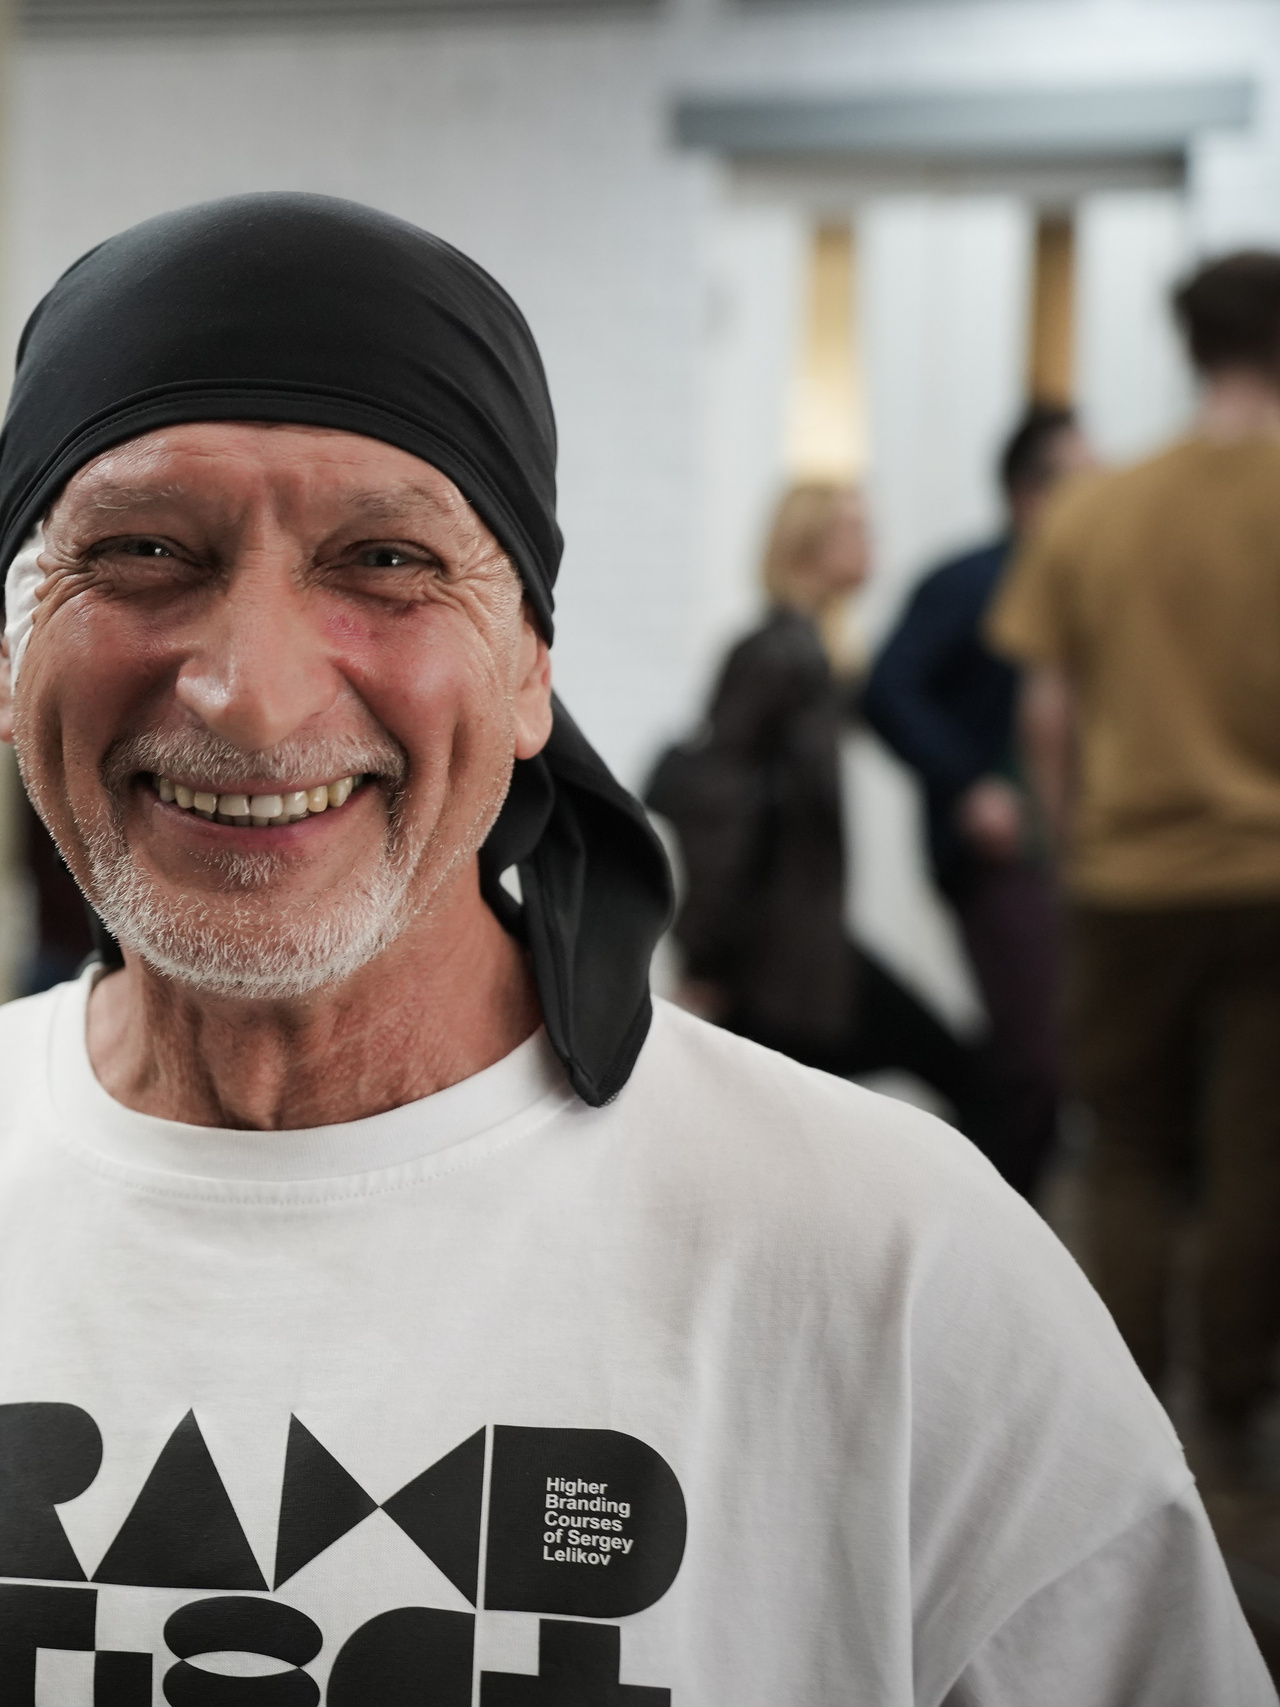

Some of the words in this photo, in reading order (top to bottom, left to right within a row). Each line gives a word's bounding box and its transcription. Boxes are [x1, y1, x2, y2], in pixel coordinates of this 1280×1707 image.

[546, 1477, 608, 1496] Higher
[545, 1493, 631, 1518] Branding
[544, 1510, 623, 1532] Courses
[543, 1528, 564, 1544] of
[567, 1529, 634, 1555] Sergey
[543, 1545, 611, 1566] Lelikov
